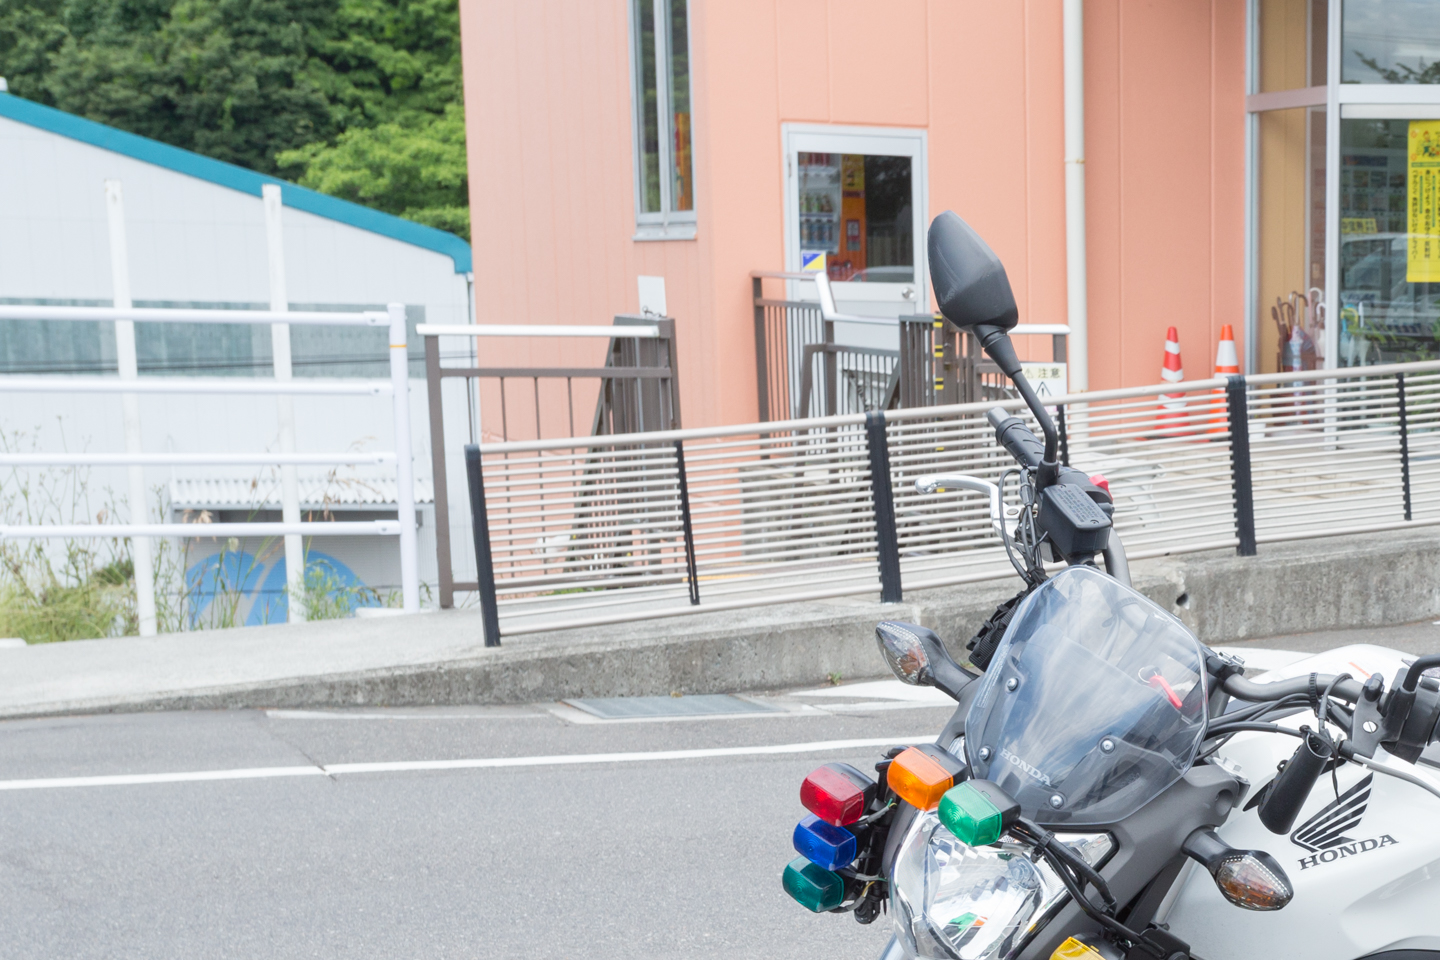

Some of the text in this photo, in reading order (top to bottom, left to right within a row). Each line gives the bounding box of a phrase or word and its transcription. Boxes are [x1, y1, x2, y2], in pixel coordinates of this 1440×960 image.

[1037, 366, 1061, 379] 注意
[999, 747, 1051, 787] HONDA
[1297, 833, 1399, 871] HONDA
